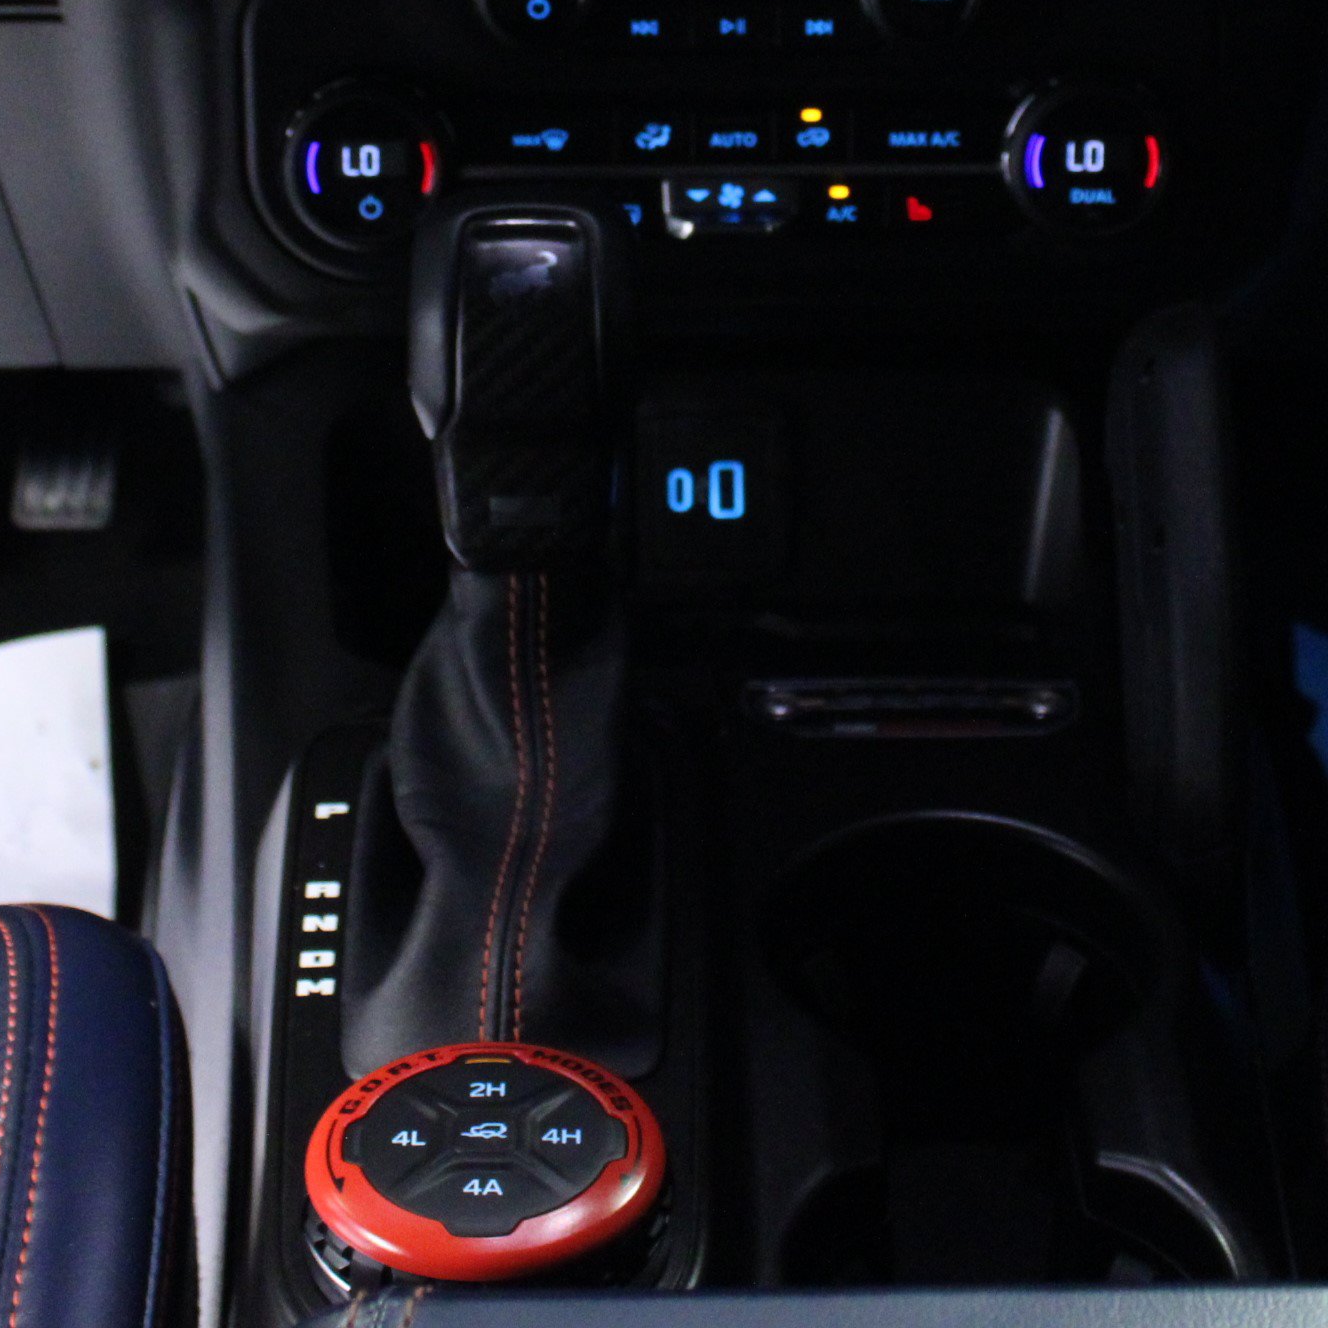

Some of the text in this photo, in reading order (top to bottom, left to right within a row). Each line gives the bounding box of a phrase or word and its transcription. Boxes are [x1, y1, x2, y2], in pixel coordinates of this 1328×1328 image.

[709, 131, 759, 149] AUTO
[888, 130, 962, 149] MAX A/C
[341, 144, 381, 177] LO
[1065, 140, 1105, 173] LO
[1069, 187, 1118, 205] DUAL
[826, 205, 858, 224] A/C
[302, 915, 339, 933] N
[298, 950, 336, 968] D
[295, 978, 336, 997] M
[469, 1082, 506, 1099] 2H
[391, 1128, 582, 1148] 4L 4H
[462, 1179, 503, 1197] 4A
